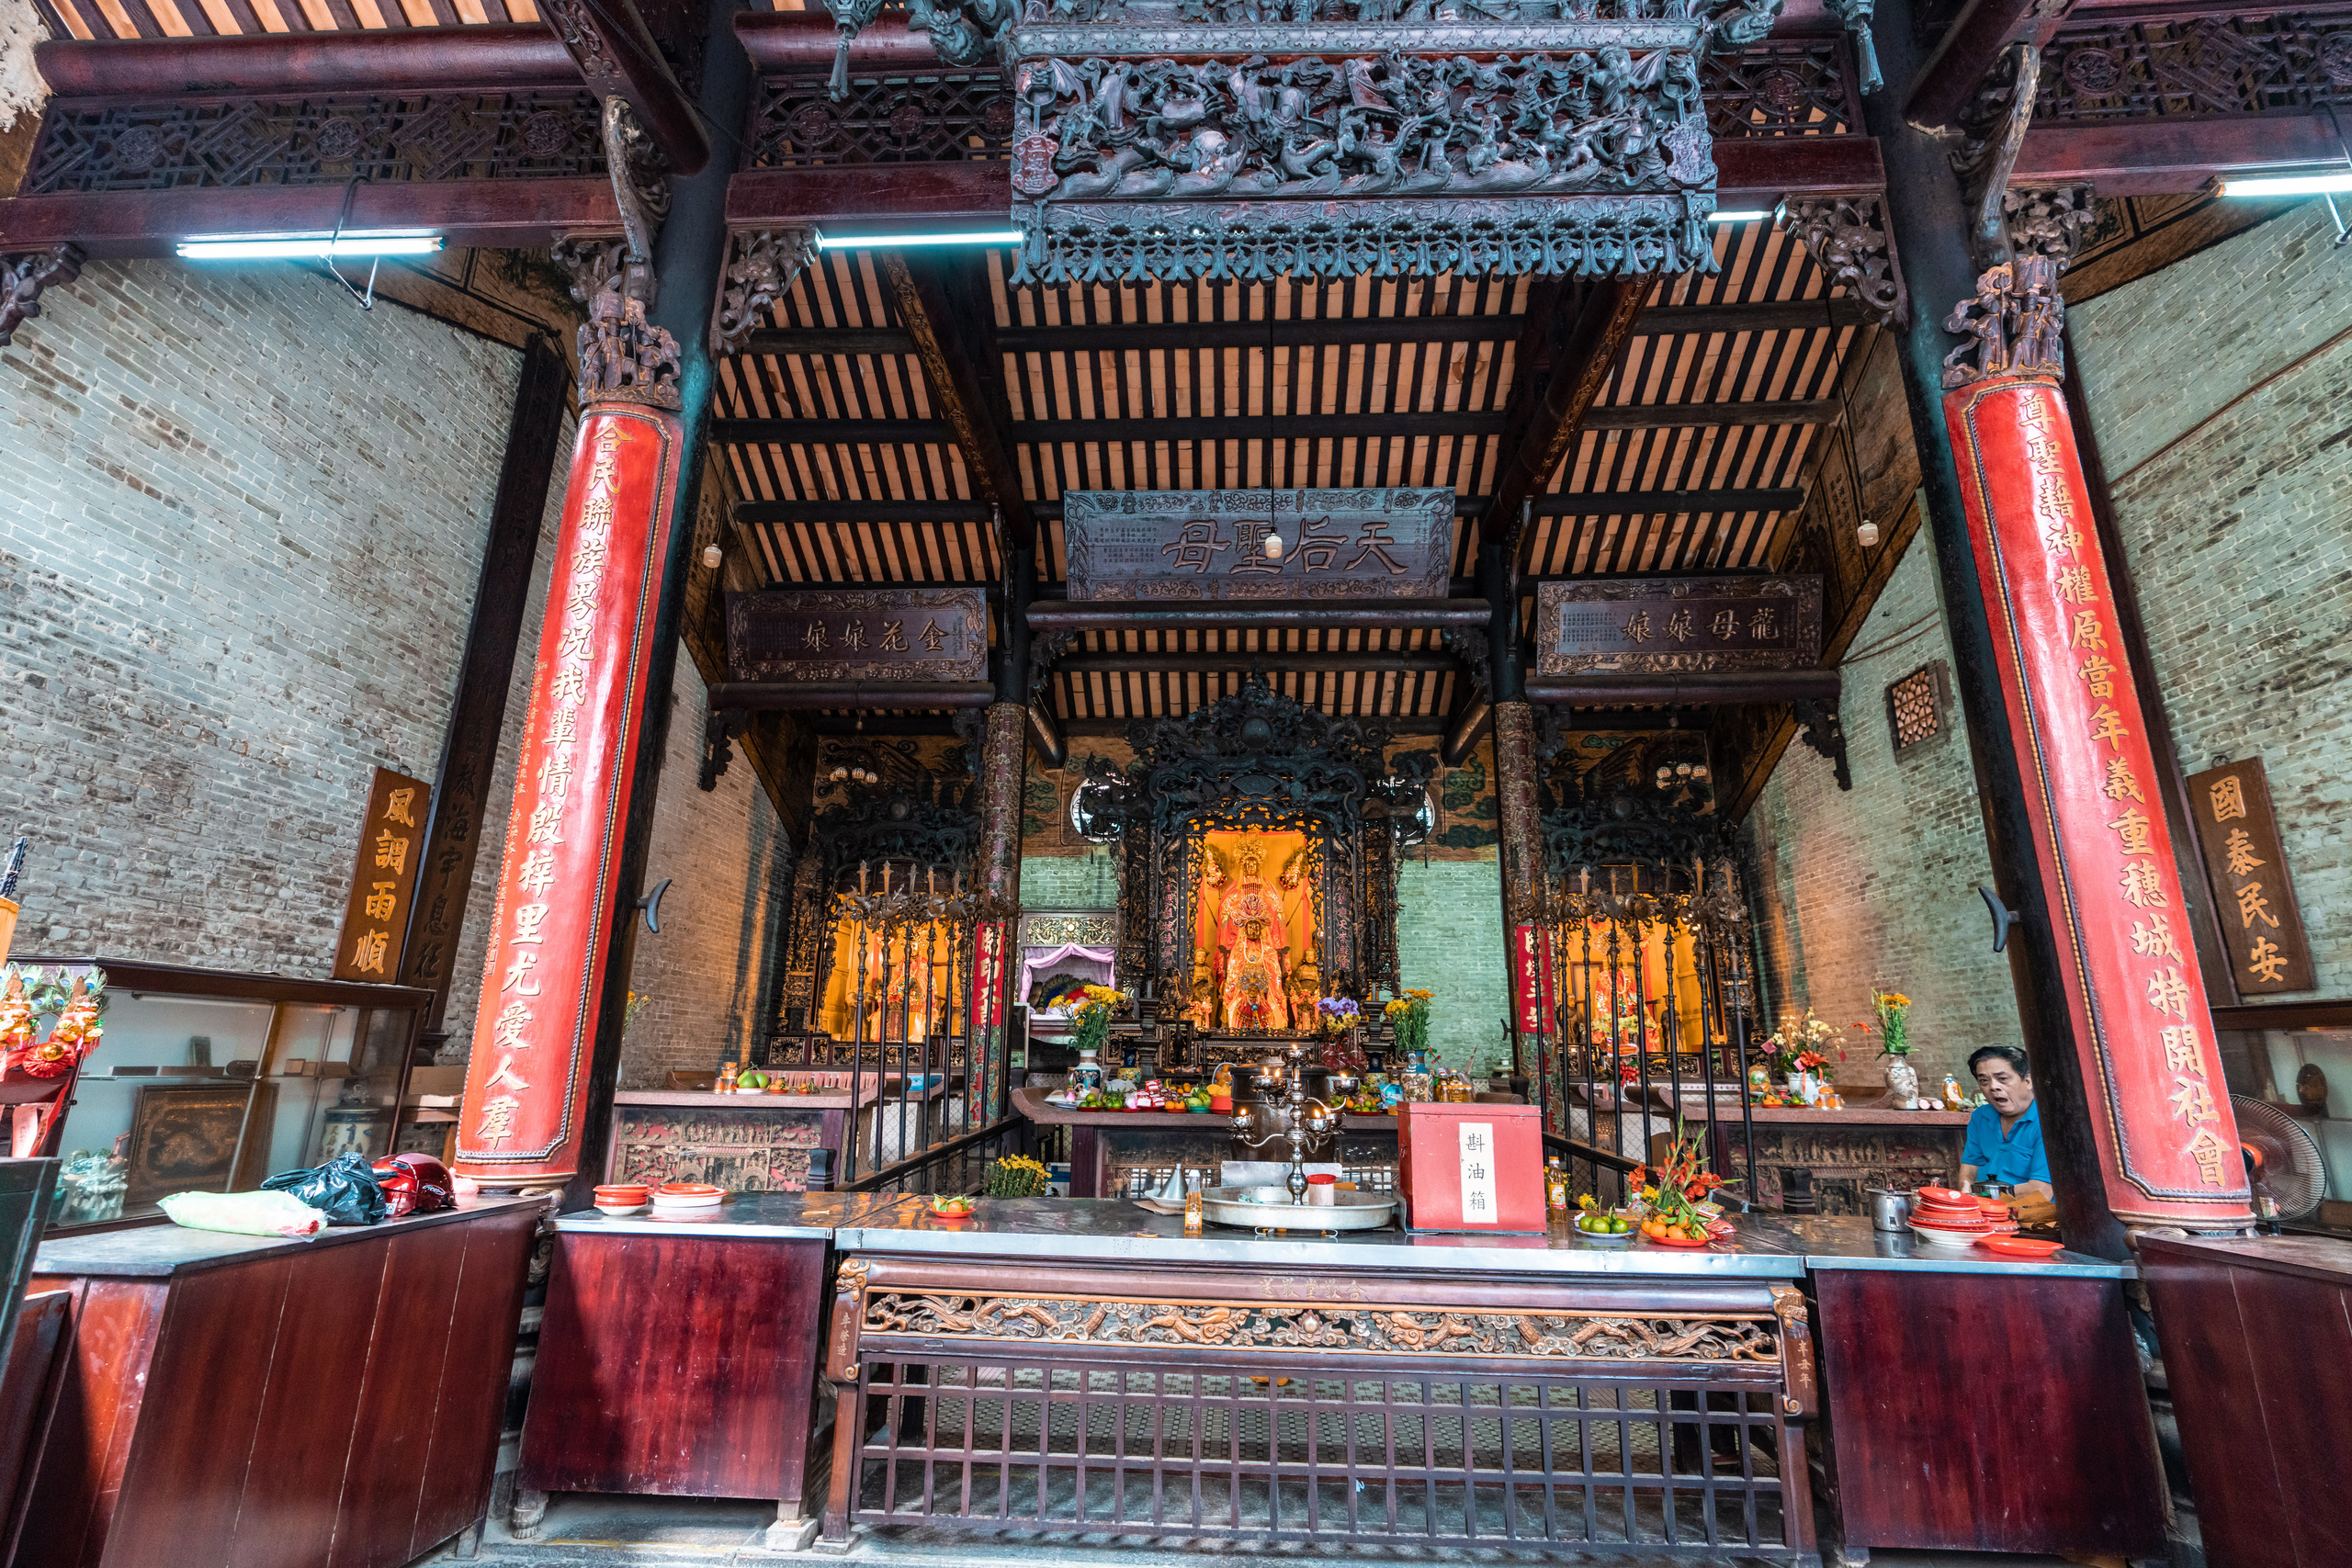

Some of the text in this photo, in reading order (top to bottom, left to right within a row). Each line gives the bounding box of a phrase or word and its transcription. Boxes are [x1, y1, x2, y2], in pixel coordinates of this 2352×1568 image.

[1161, 514, 1409, 576] 天后聖母
[801, 616, 950, 653] 金花娘娘
[1620, 606, 1780, 646] 龍母娘娘
[350, 786, 415, 975] 風調雨順
[2210, 773, 2289, 984] 國泰民安
[1465, 1133, 1486, 1211] 斟油箱
[1797, 1339, 1813, 1389] 辛丑年
